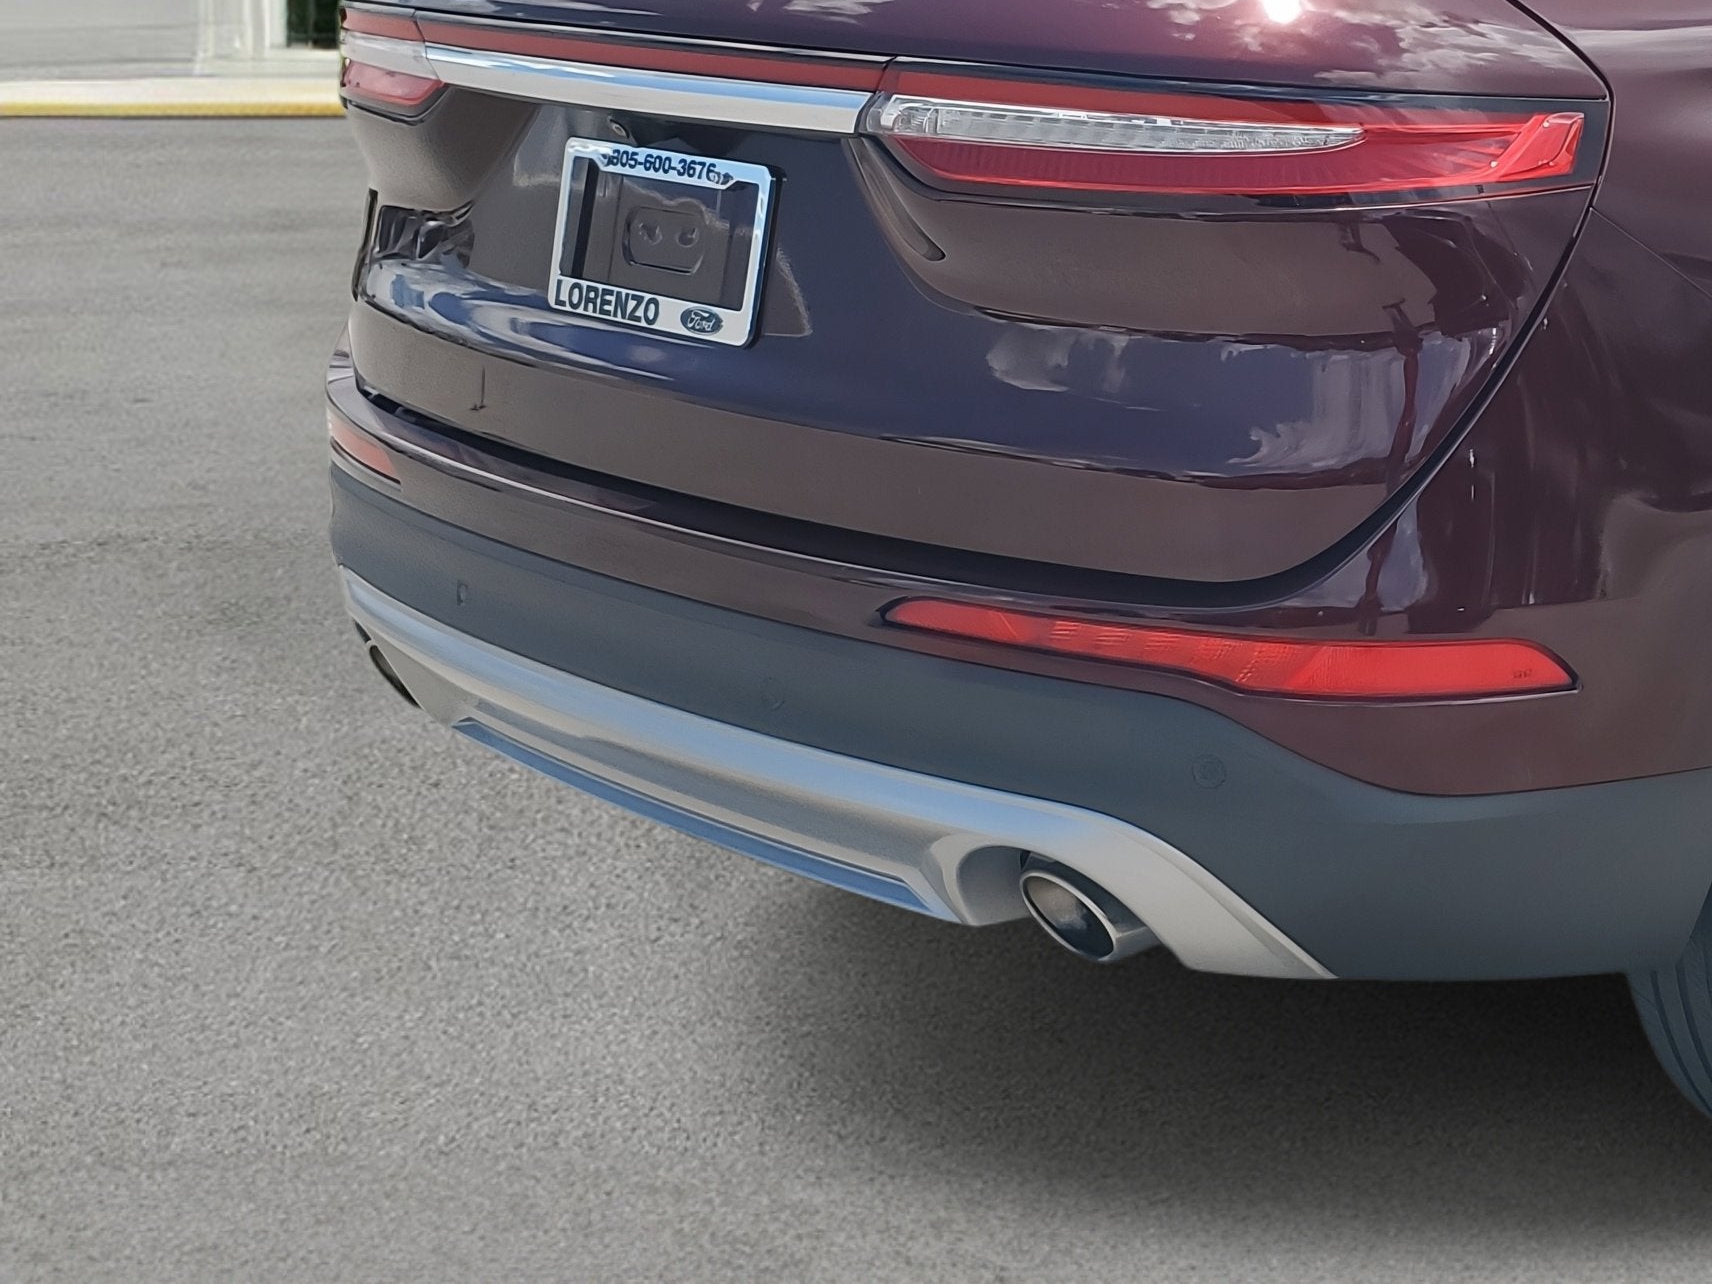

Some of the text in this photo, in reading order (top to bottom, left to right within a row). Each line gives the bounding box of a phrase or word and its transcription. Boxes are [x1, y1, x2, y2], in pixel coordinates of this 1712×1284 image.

[611, 149, 716, 183] 305-600-3676
[554, 279, 660, 326] LORENZO
[687, 310, 716, 332] Ford
